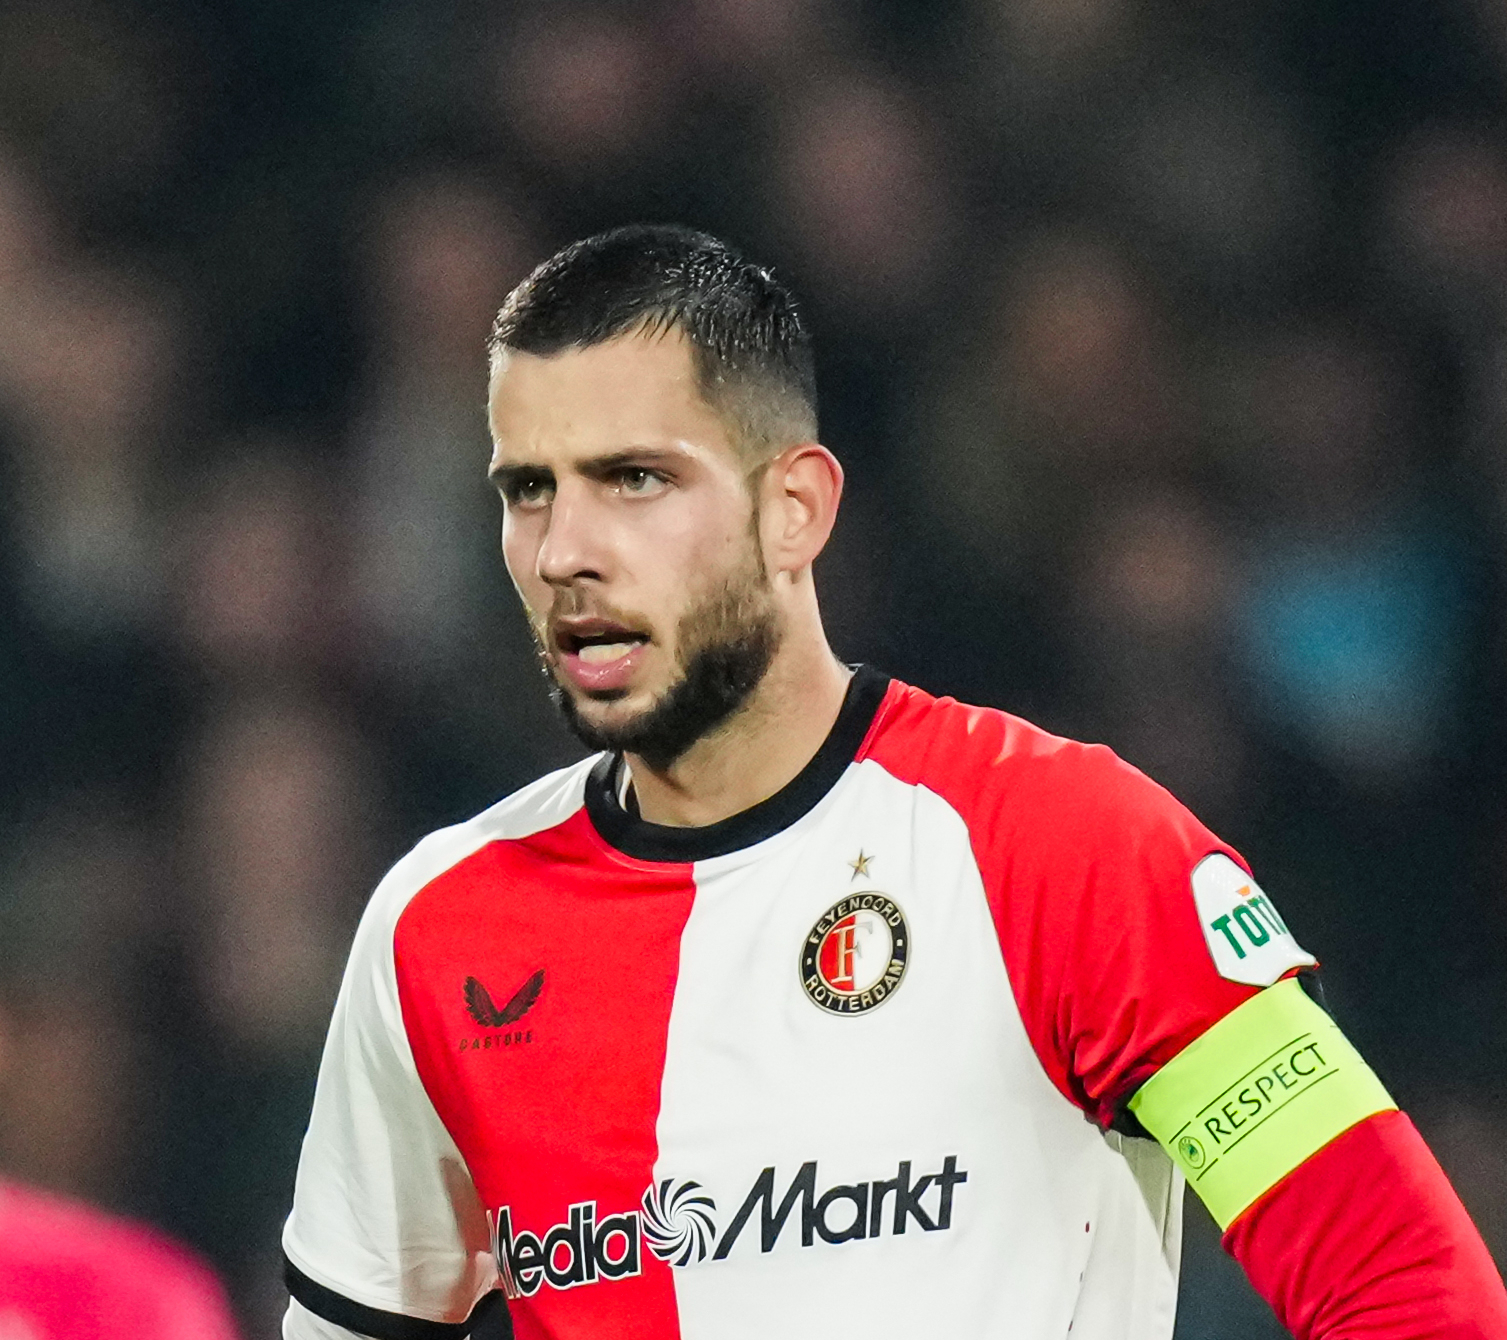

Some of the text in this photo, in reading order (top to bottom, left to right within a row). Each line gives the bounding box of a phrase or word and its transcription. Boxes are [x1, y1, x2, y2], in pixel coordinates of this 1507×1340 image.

[809, 895, 902, 945] FEYENOORD
[1210, 894, 1287, 960] TOT
[805, 957, 905, 1012] ROTTERDAM
[459, 1030, 532, 1053] CASTORE
[1203, 1041, 1327, 1145] RESPECT
[711, 1154, 969, 1262] Markt
